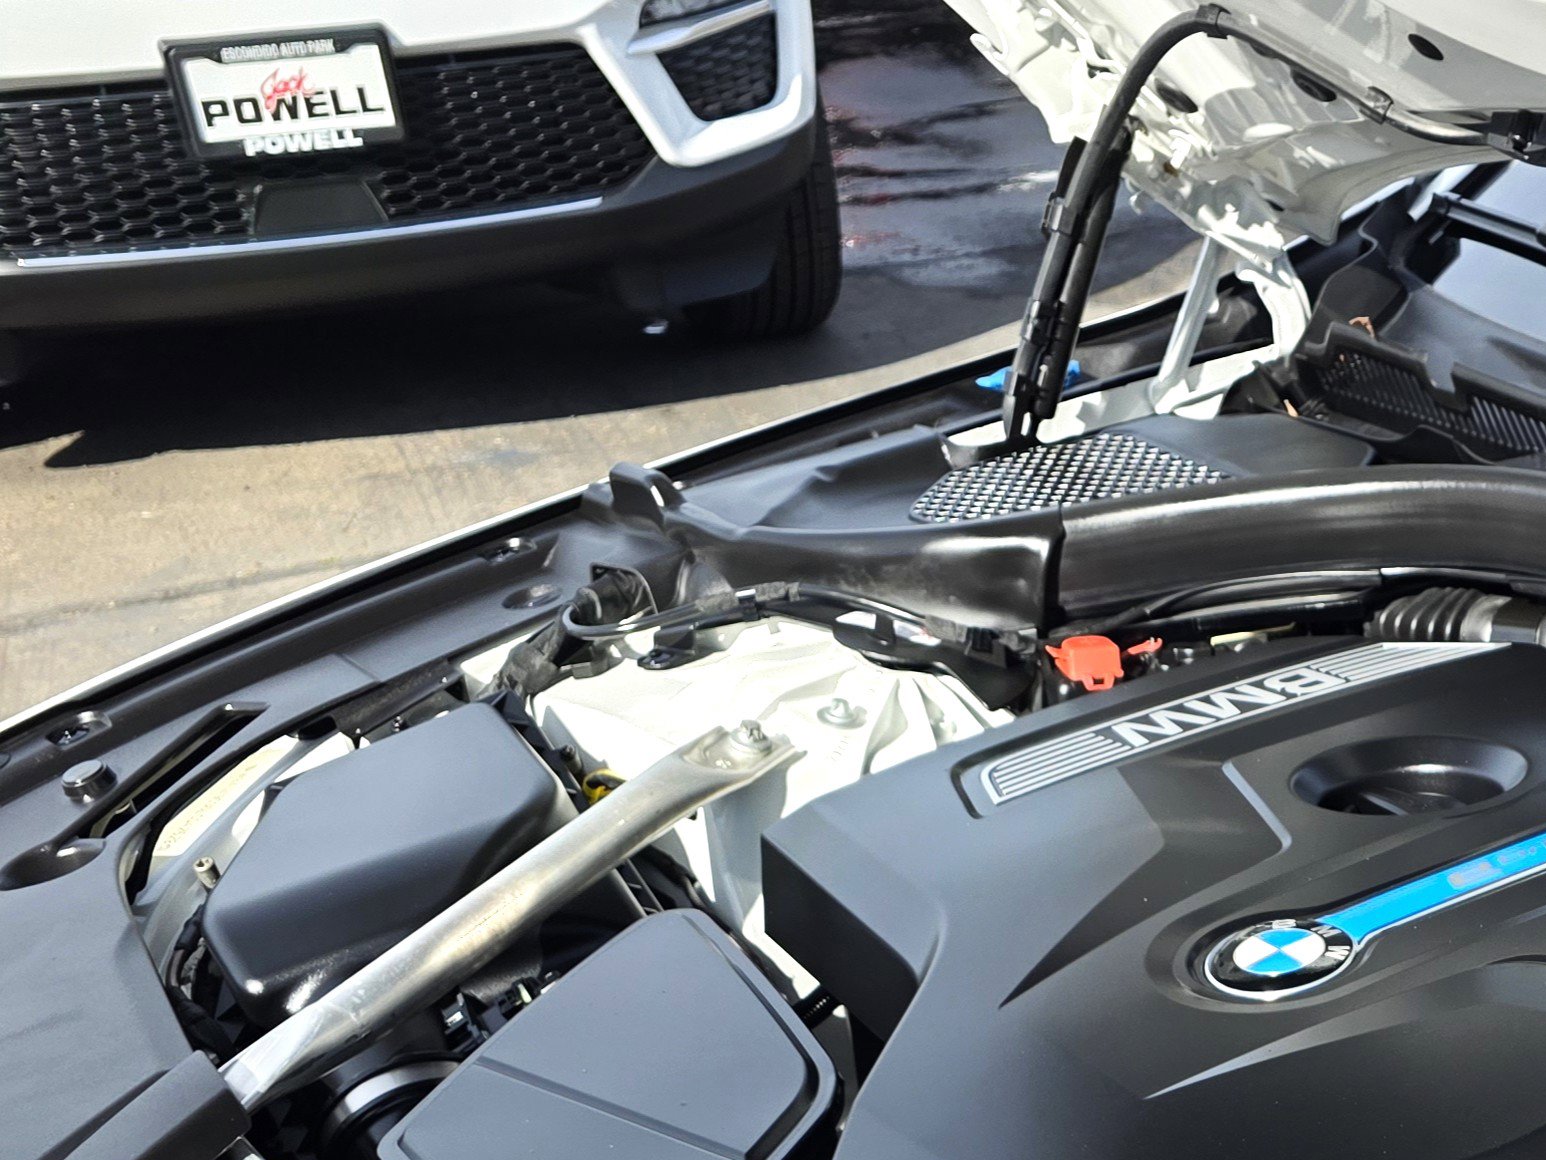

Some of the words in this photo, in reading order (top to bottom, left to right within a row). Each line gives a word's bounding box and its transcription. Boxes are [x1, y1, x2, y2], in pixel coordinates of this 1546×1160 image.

[220, 44, 279, 63] ESCONDIDO
[280, 41, 306, 58] AUTO
[308, 38, 336, 55] PARK
[201, 86, 385, 127] POWELL
[245, 129, 363, 156] POWELL
[1110, 667, 1347, 748] BMW
